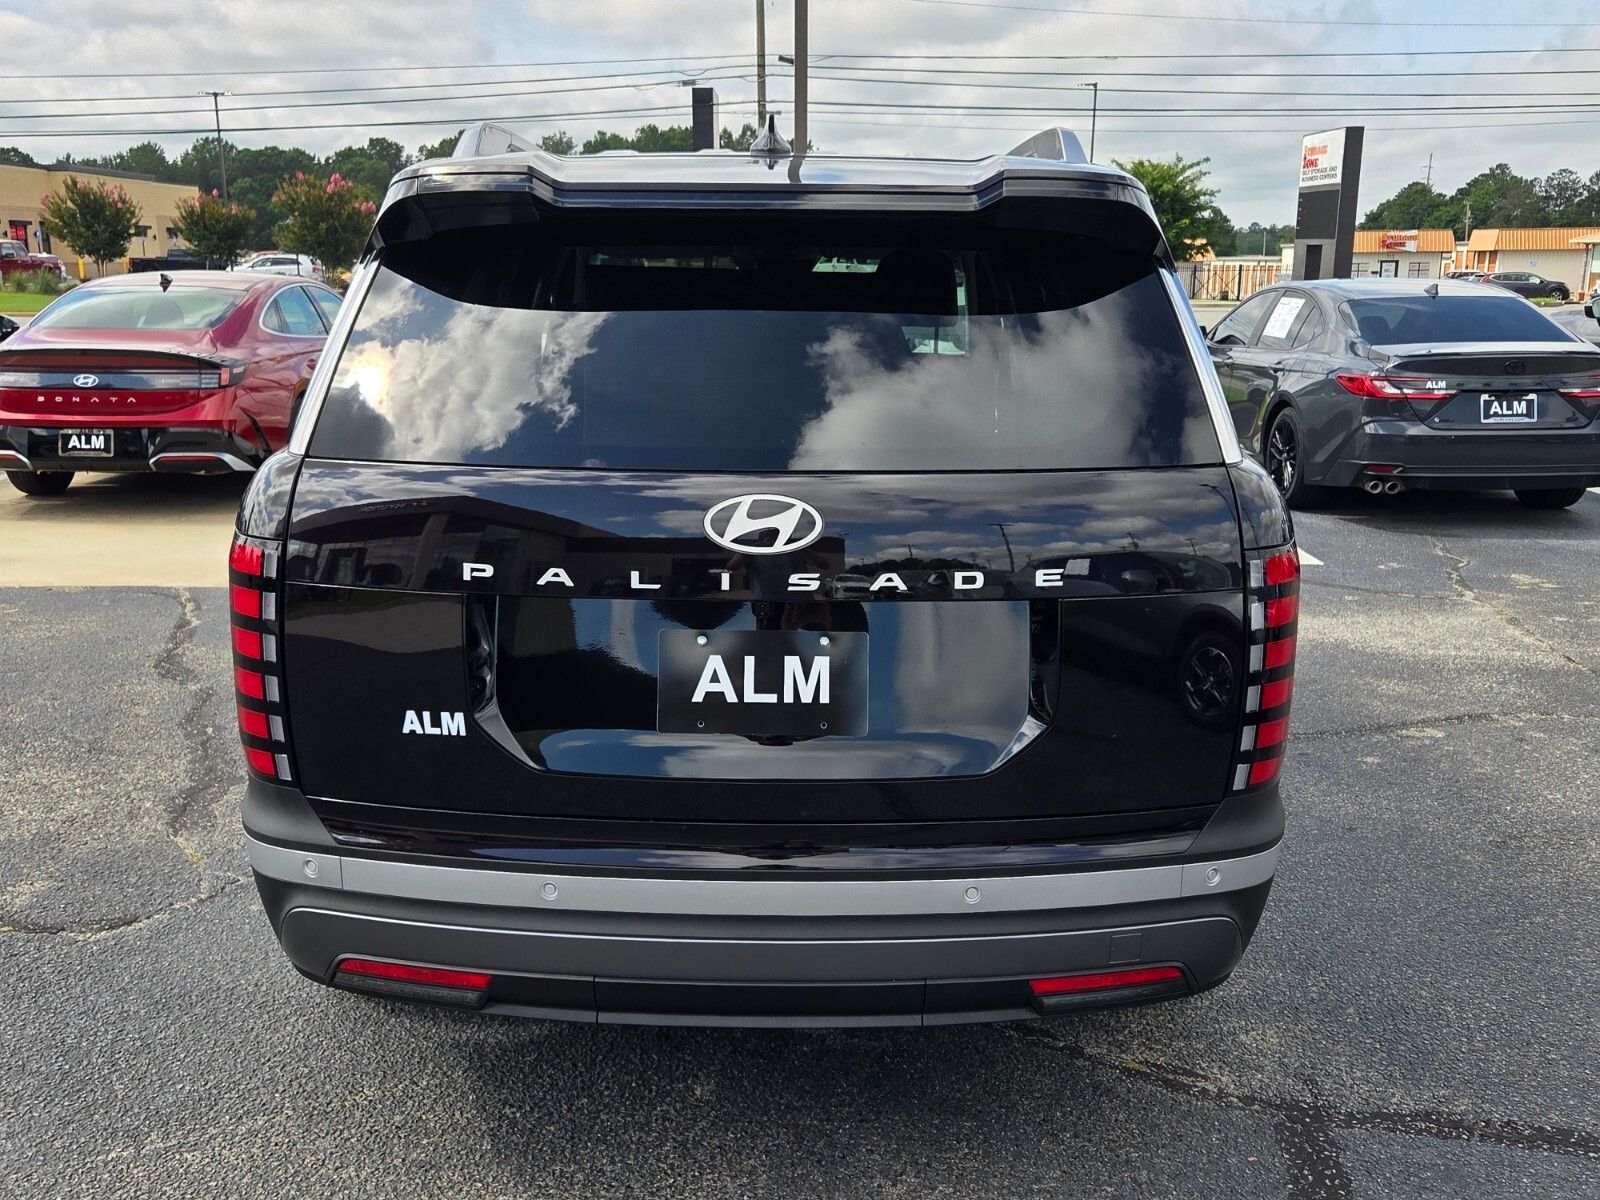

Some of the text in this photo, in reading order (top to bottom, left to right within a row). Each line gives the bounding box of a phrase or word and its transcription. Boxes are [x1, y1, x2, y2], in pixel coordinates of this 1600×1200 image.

[1425, 380, 1446, 389] ALM
[1489, 400, 1527, 415] ALM
[67, 434, 105, 450] ALM
[462, 562, 1064, 591] PALISADE
[692, 655, 831, 705] ALM
[402, 710, 467, 737] ALM
